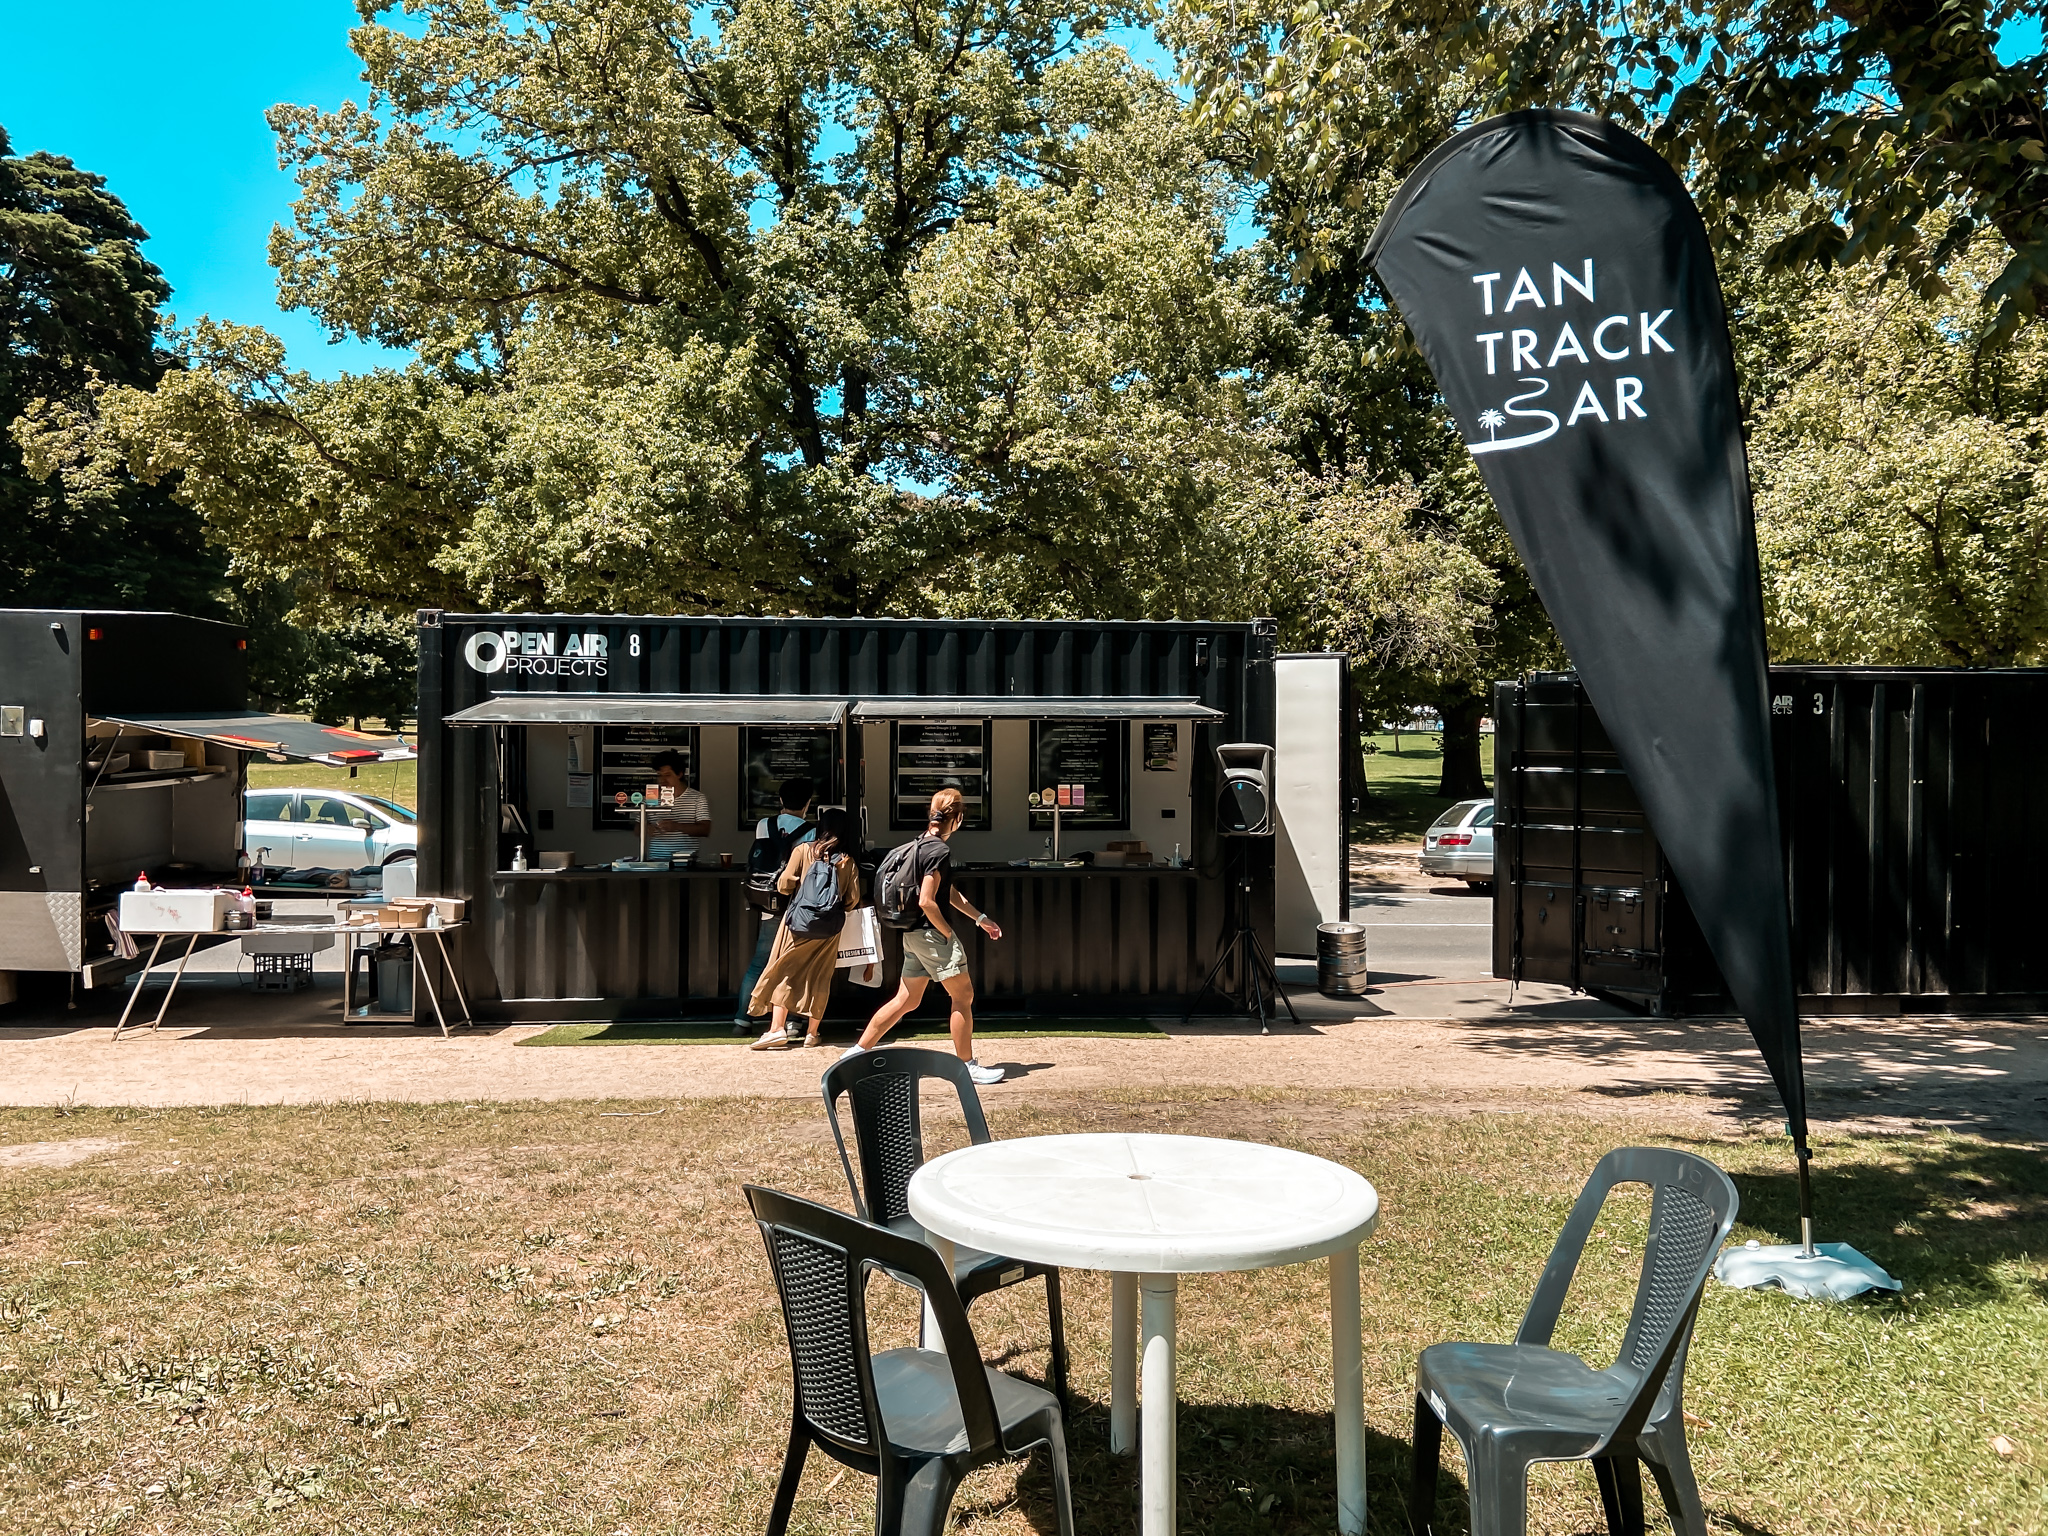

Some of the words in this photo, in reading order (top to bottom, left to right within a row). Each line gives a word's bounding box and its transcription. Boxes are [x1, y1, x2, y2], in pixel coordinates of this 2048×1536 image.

[1472, 257, 1594, 316] TAN
[1476, 308, 1675, 375] TRACK
[465, 631, 555, 673] OPEN
[563, 633, 608, 657] AIR
[630, 634, 640, 656] 8
[505, 658, 608, 675] PROJECTS
[1772, 695, 1793, 705] AIR
[1813, 693, 1823, 714] 3
